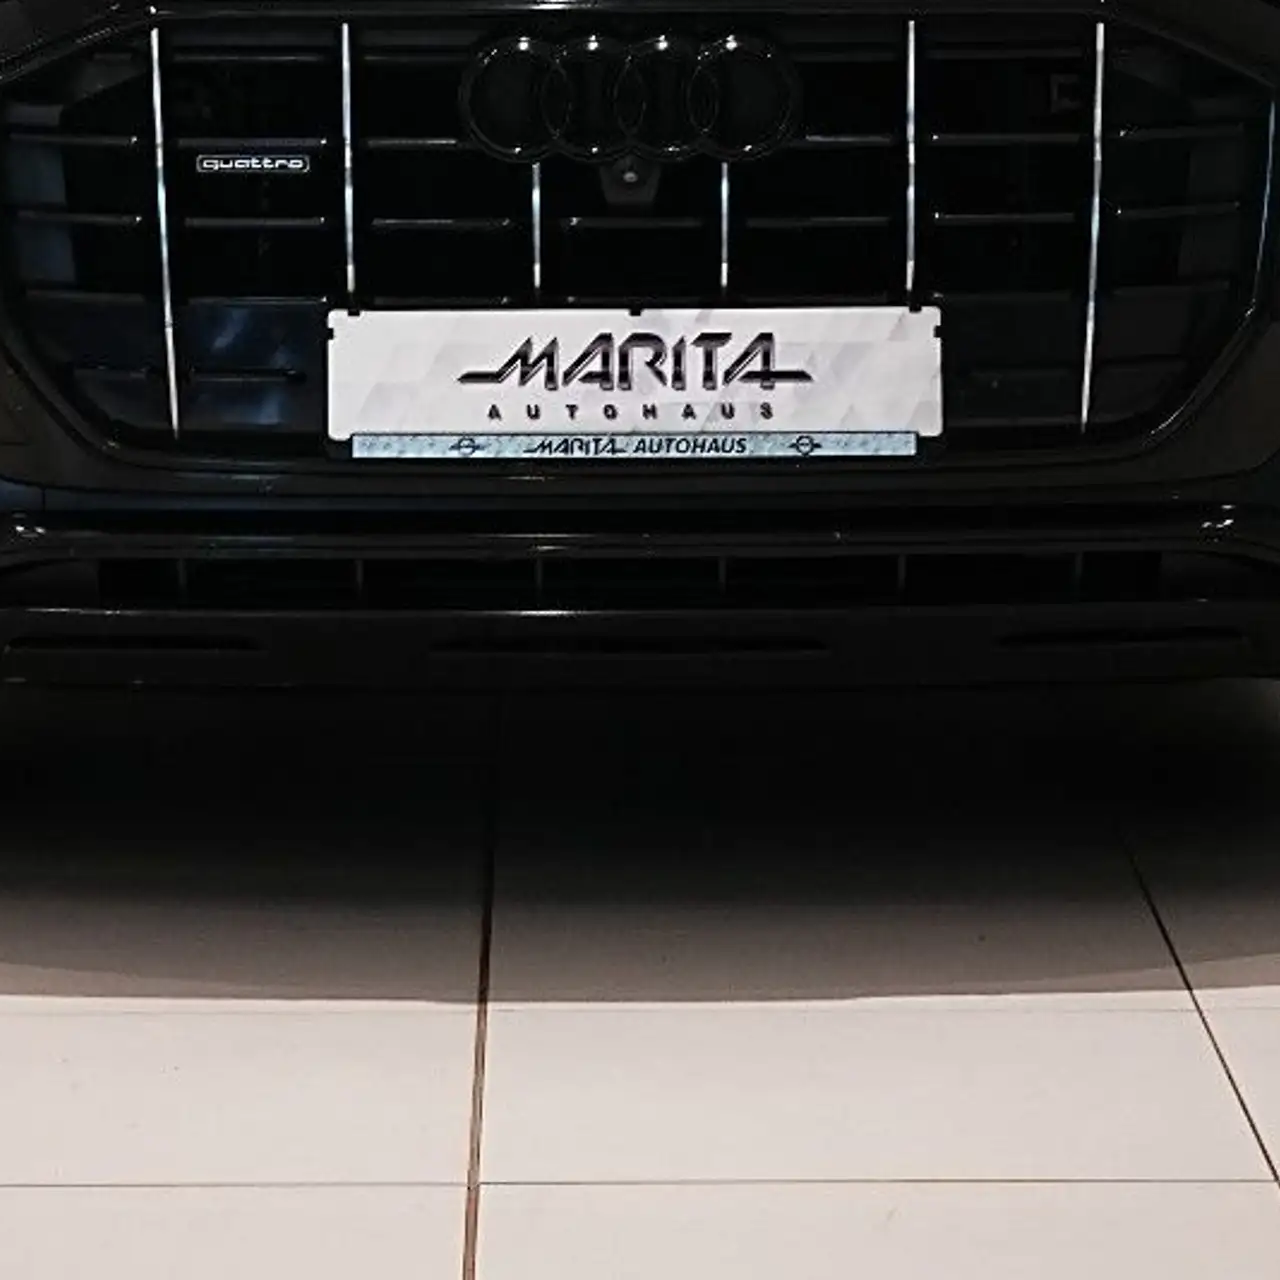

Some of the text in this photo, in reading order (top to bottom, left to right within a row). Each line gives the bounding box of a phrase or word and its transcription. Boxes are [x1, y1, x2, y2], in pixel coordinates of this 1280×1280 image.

[202, 157, 304, 170] quattro
[457, 332, 813, 390] MARITA
[487, 403, 773, 420] AUTOHAUS
[523, 437, 747, 455] MARITA AUTOHAUS
